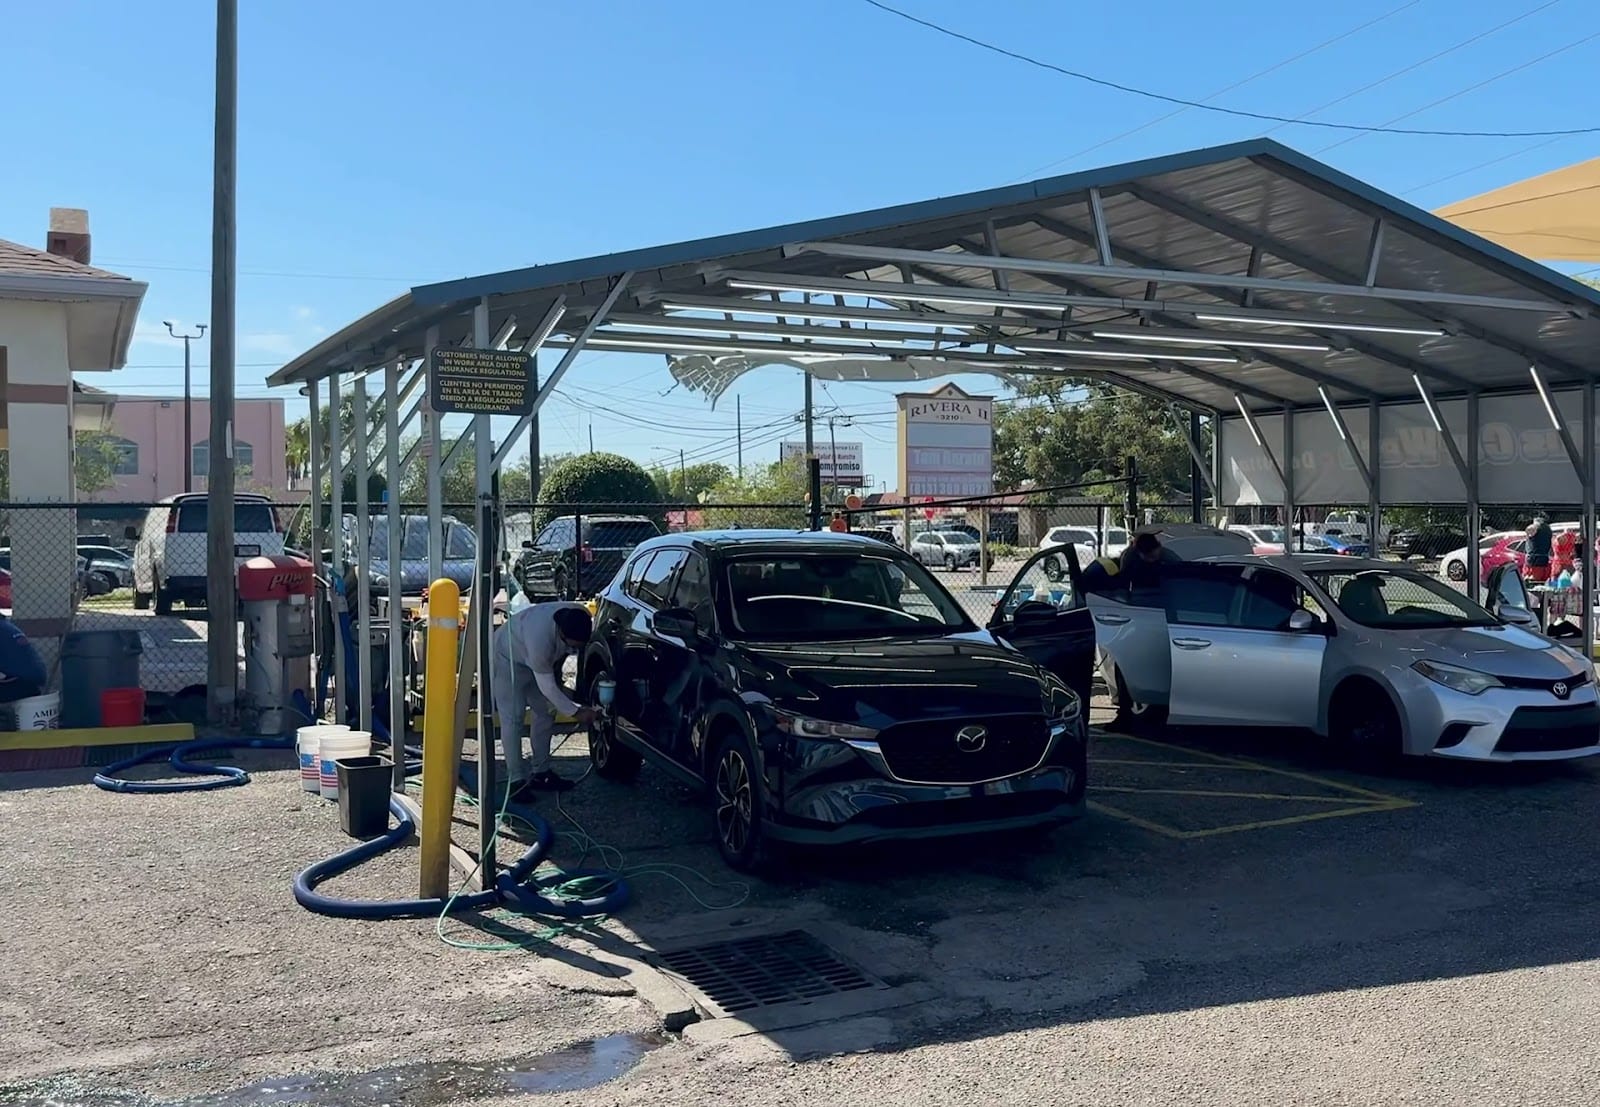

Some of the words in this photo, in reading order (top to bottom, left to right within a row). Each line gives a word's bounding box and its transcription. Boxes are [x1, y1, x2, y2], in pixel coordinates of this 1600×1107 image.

[436, 351, 478, 360] CUSTOMERS
[495, 355, 528, 363] ALLOWED
[454, 359, 475, 367] WORK
[476, 360, 495, 368] AREA
[496, 361, 510, 369] DUE
[438, 366, 479, 374] INSURANCE
[479, 368, 526, 377] REGULATIONS
[439, 380, 471, 388] CLIENTES
[472, 381, 483, 389] NO
[484, 382, 525, 391] PERMITIDOS
[492, 390, 522, 398] TRABAJO
[474, 396, 525, 405] REGULACIONES
[464, 403, 511, 411] ASEGURANZA
[911, 402, 972, 417] RIVERA
[978, 408, 988, 420] II
[819, 461, 861, 473] ompromiso
